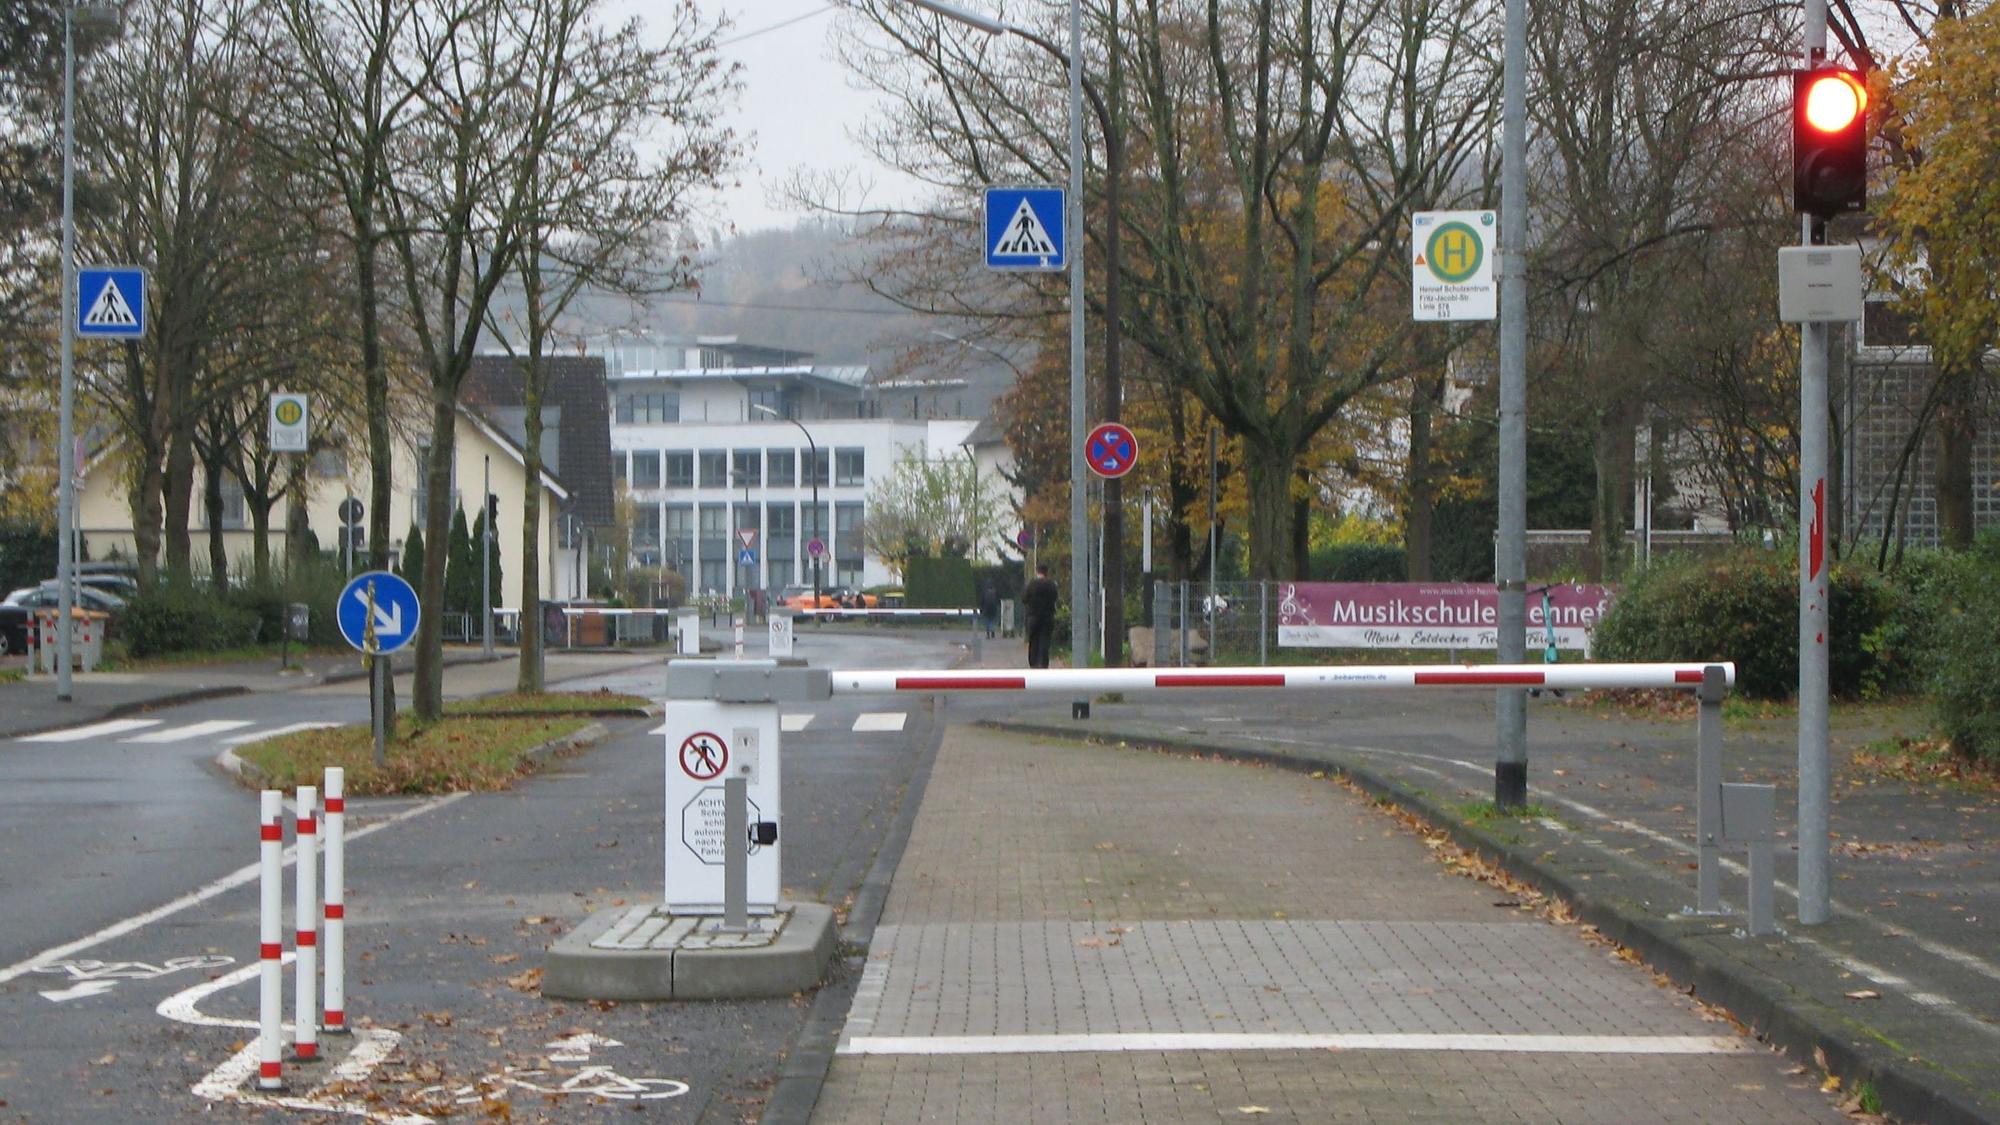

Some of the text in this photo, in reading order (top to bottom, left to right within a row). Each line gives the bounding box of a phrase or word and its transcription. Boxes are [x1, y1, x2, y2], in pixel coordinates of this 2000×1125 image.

[1443, 234, 1466, 268] H
[1419, 285, 1442, 293] Hennef
[1333, 599, 1608, 624] Musikschule ennef
[1364, 630, 1400, 645] Musik
[1411, 630, 1469, 645] Entdecken
[701, 808, 725, 817] Schra
[694, 828, 725, 836] automa
[695, 838, 717, 847] nach
